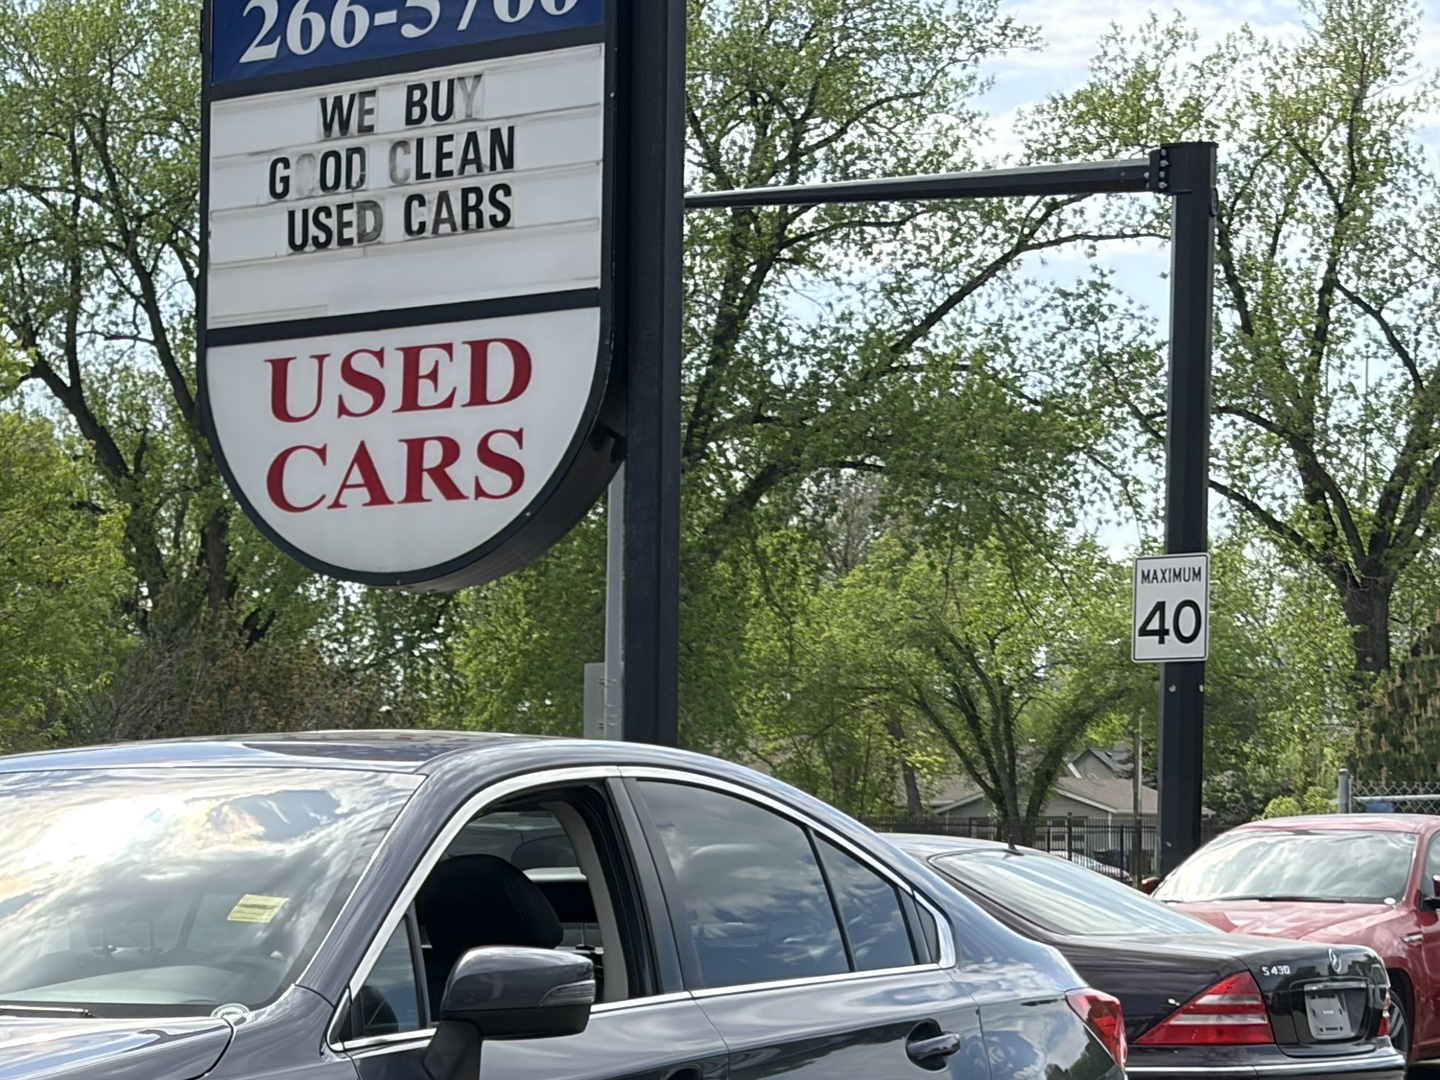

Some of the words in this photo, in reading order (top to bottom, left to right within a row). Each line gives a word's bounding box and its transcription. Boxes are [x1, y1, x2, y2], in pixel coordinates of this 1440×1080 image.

[320, 90, 376, 138] WE
[405, 74, 483, 126] BUY
[389, 126, 515, 184] CLEAN
[288, 200, 383, 252] USED
[404, 183, 512, 237] CARS
[264, 338, 532, 423] USED
[266, 428, 525, 513] CARS
[1140, 566, 1201, 585] MAXIMUM
[1138, 599, 1202, 645] 40
[1261, 966, 1271, 976] S
[1271, 965, 1291, 975] 430
